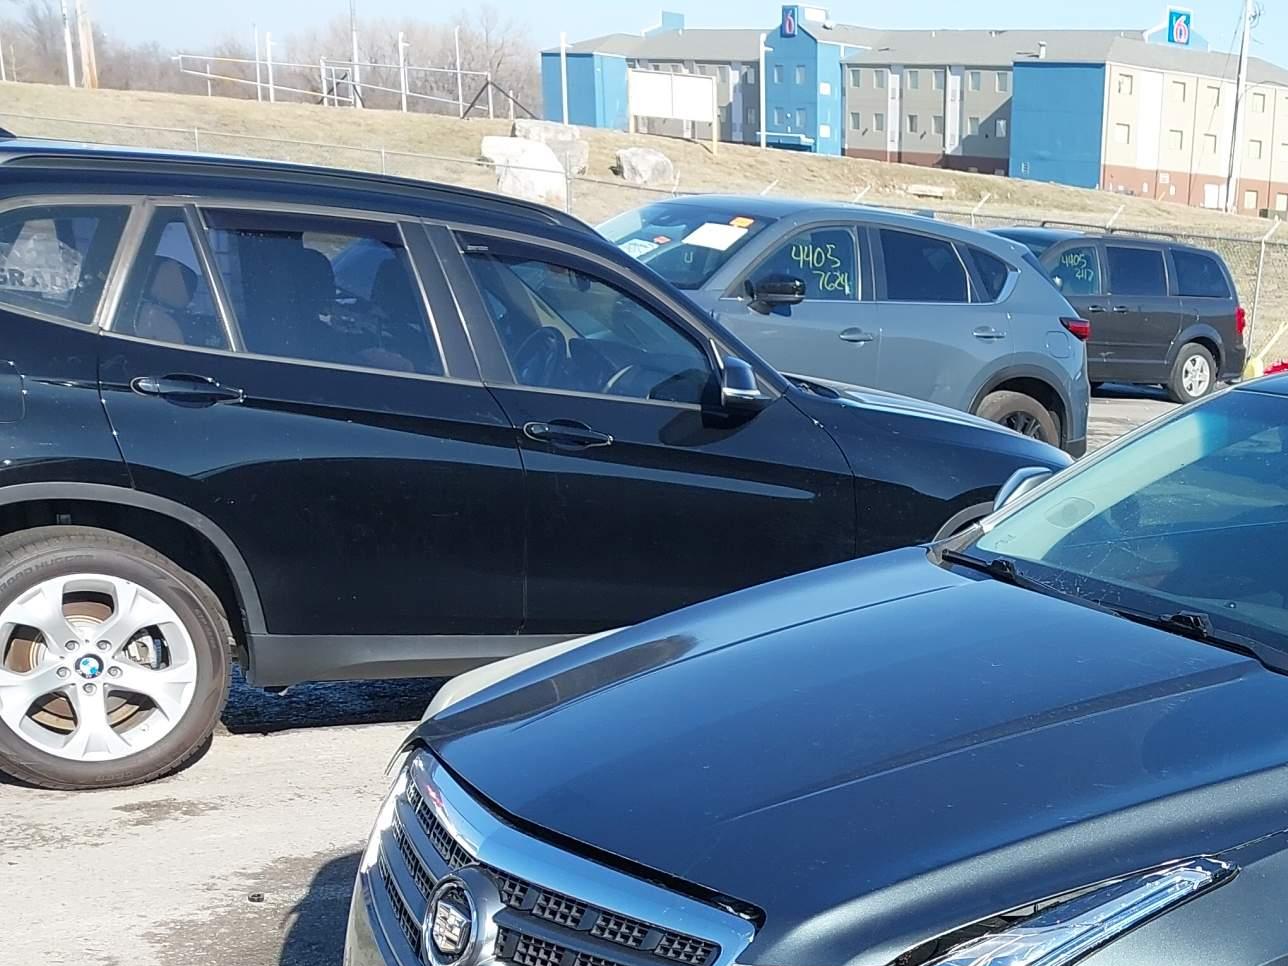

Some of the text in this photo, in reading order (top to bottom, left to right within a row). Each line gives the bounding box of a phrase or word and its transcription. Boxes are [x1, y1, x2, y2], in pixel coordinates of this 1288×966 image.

[1173, 15, 1189, 43] 6
[791, 244, 841, 269] 4405
[1061, 253, 1087, 268] 4405
[812, 270, 850, 296] 7624
